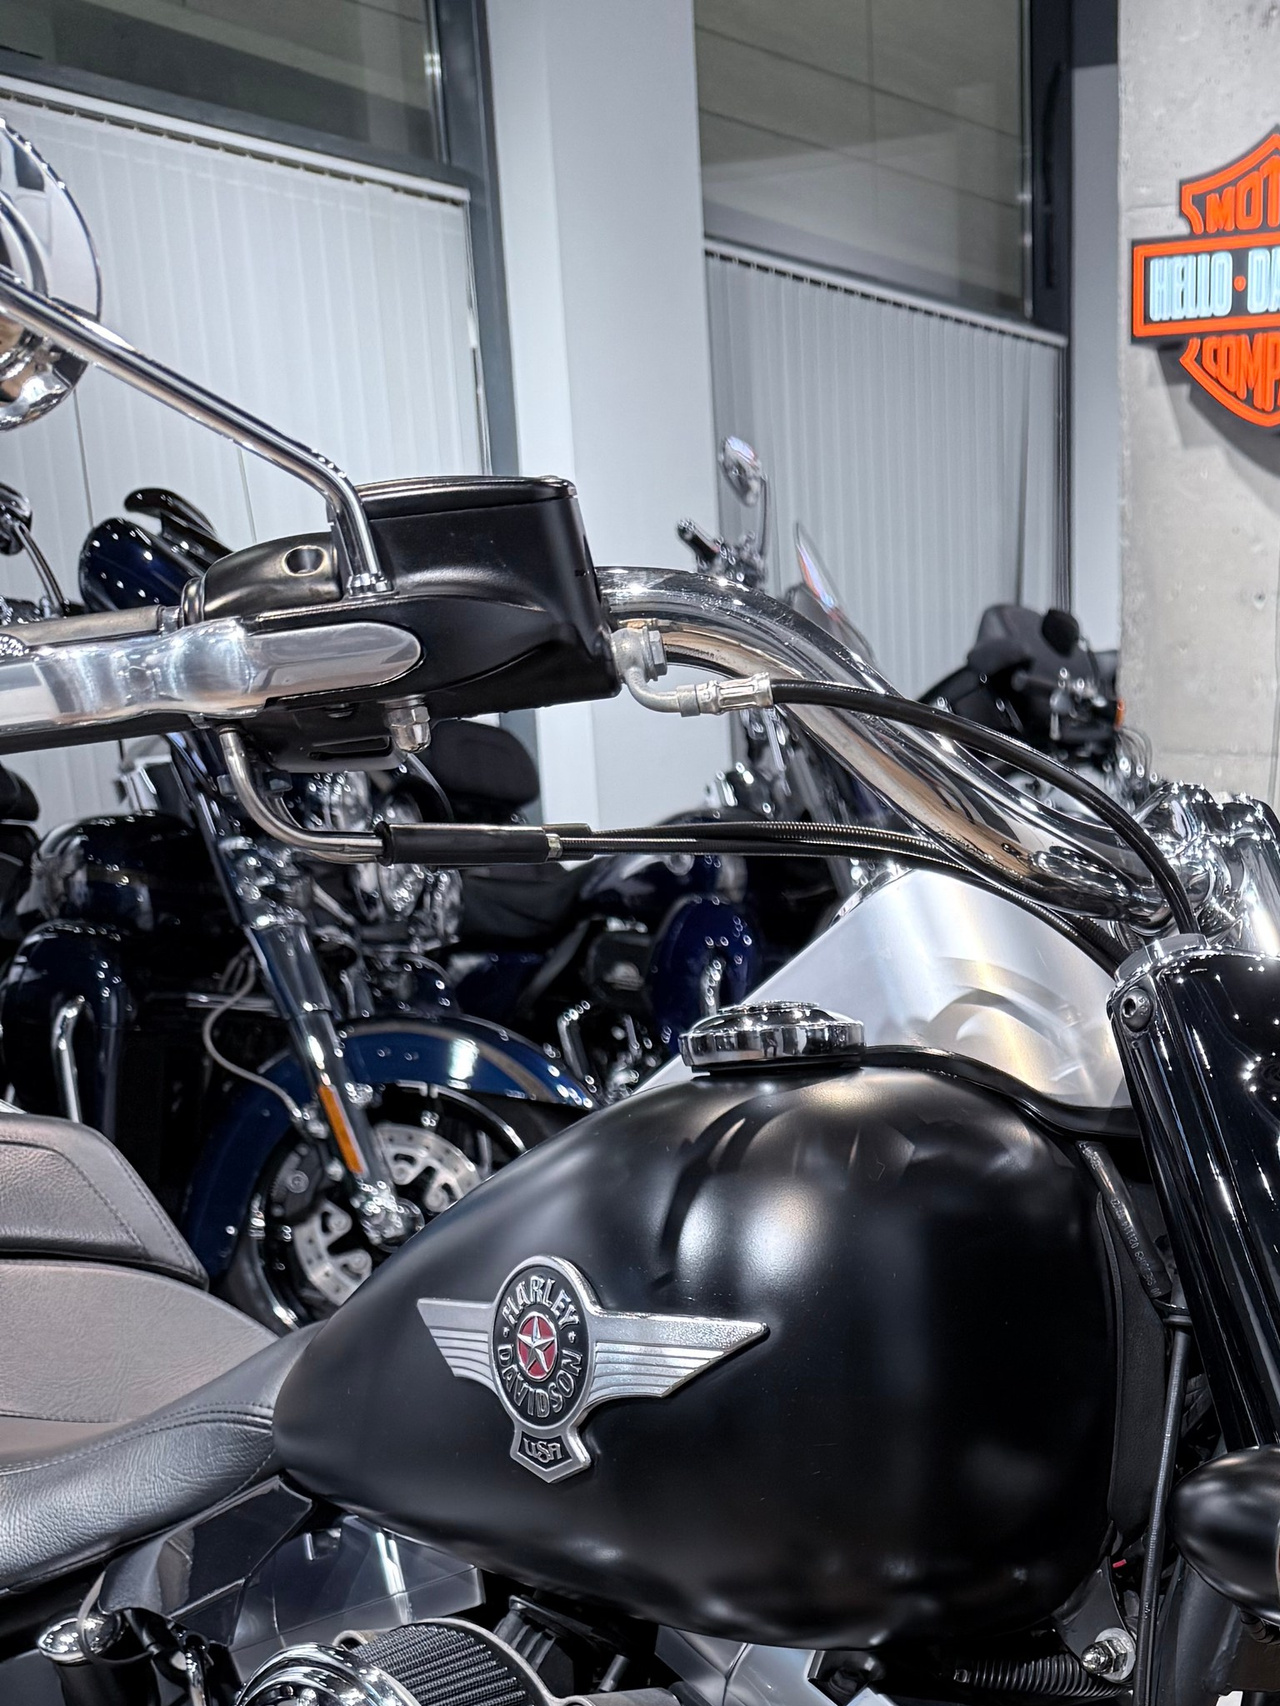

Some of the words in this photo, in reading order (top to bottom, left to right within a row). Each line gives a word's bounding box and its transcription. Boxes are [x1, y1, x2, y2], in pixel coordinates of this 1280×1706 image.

[502, 1275, 581, 1329] HARLEY
[498, 1344, 583, 1418] DAVIDSON
[523, 1437, 563, 1463] USA
